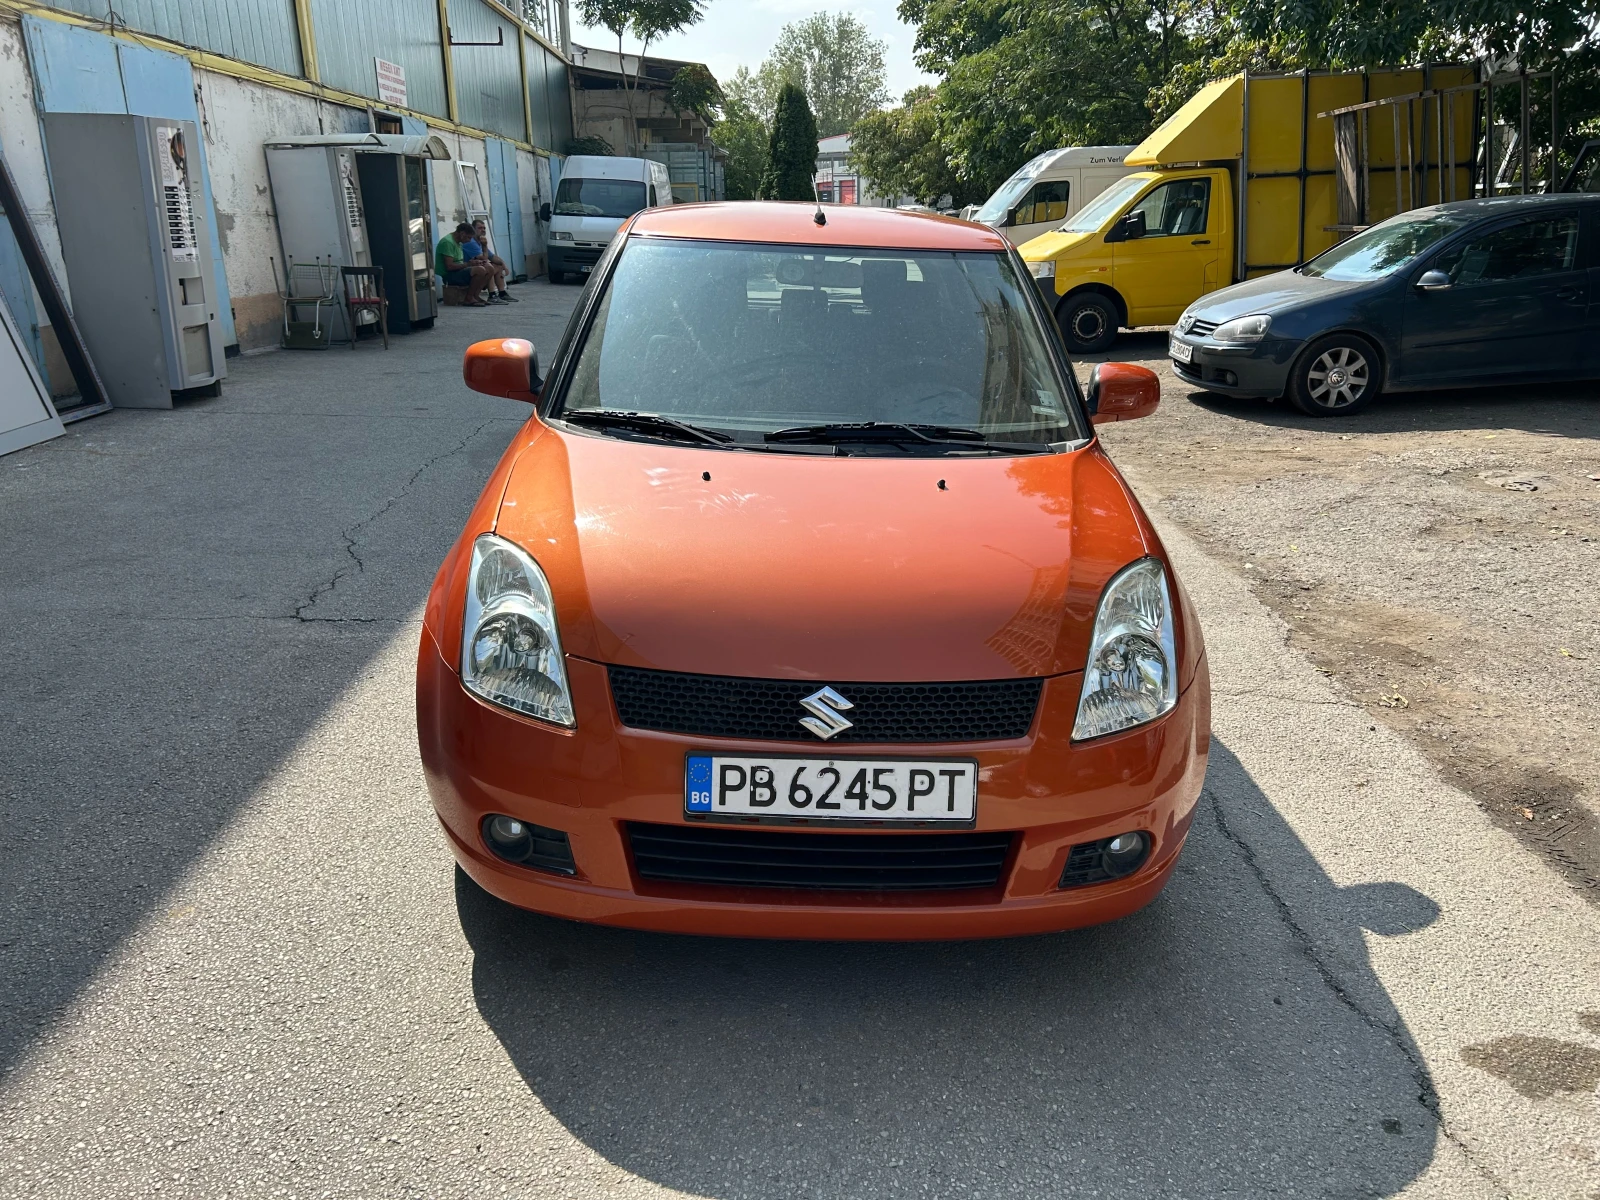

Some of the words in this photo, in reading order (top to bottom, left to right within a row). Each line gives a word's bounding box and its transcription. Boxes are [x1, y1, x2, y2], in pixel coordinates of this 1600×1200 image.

[158, 131, 171, 181] ESPRESSO
[691, 792, 710, 803] BG
[718, 764, 777, 807] PB
[788, 766, 897, 811] 6245
[906, 769, 966, 812] PT
